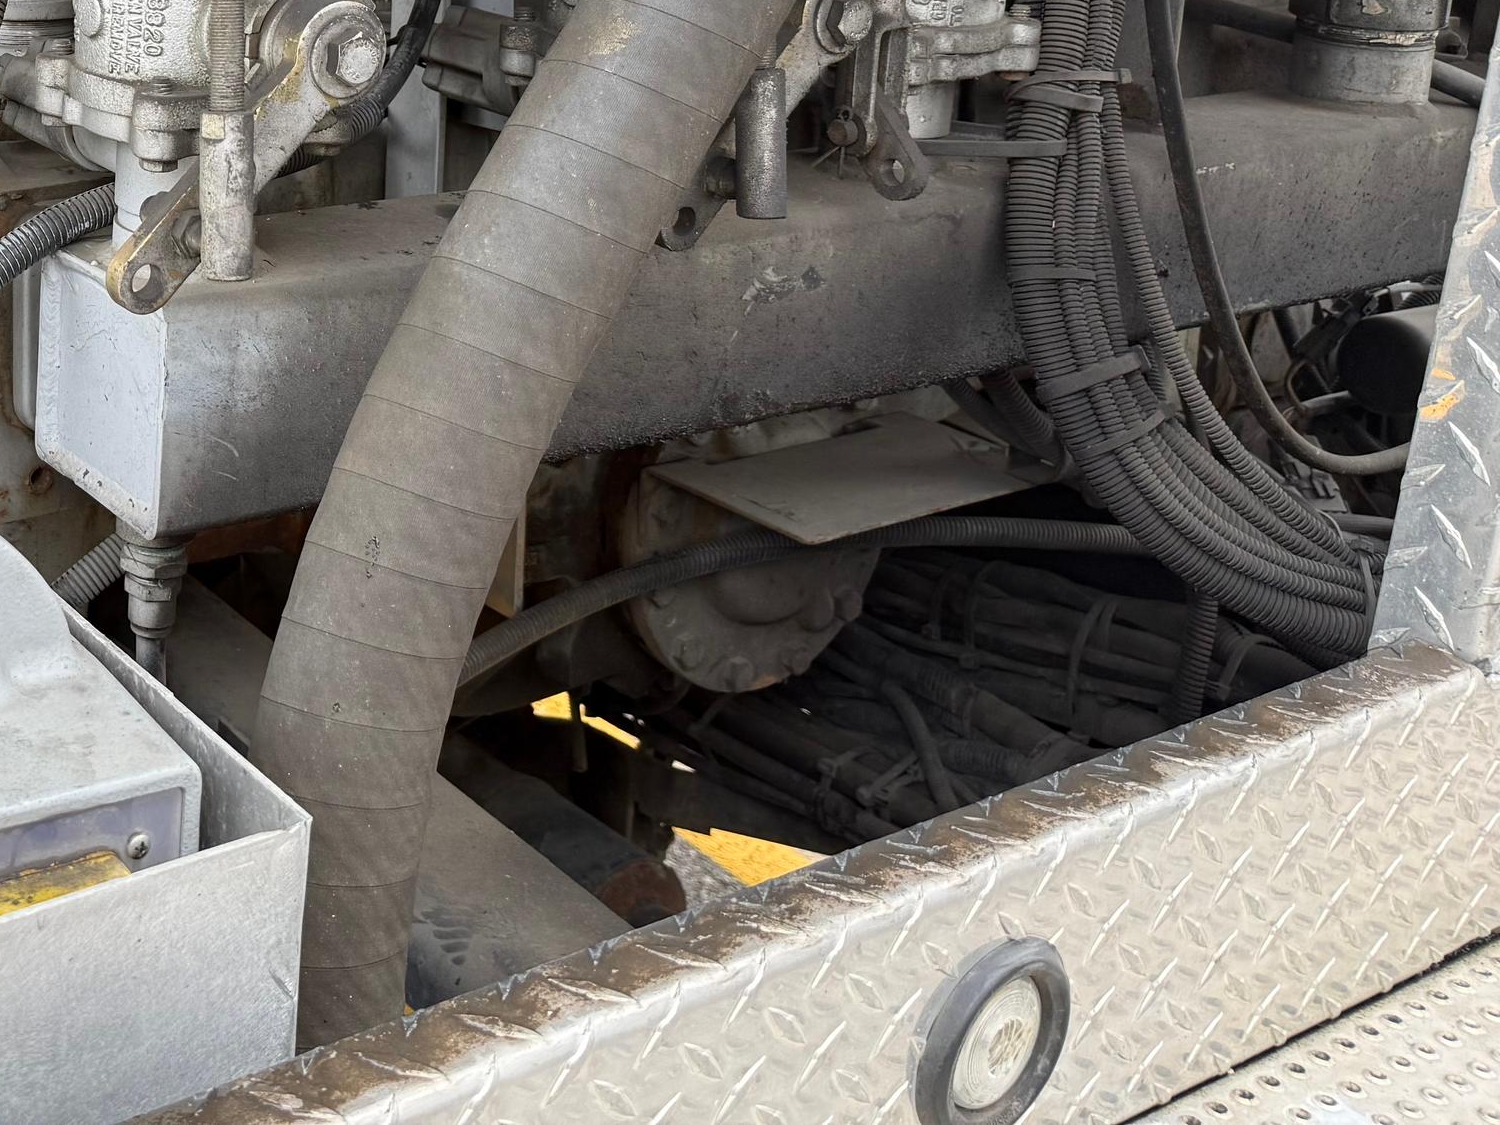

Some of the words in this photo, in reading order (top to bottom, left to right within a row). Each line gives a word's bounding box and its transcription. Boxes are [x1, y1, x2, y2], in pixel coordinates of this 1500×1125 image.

[108, 2, 125, 75] REMOVE
[948, 5, 965, 26] TO
[125, 19, 144, 75] VALVE
